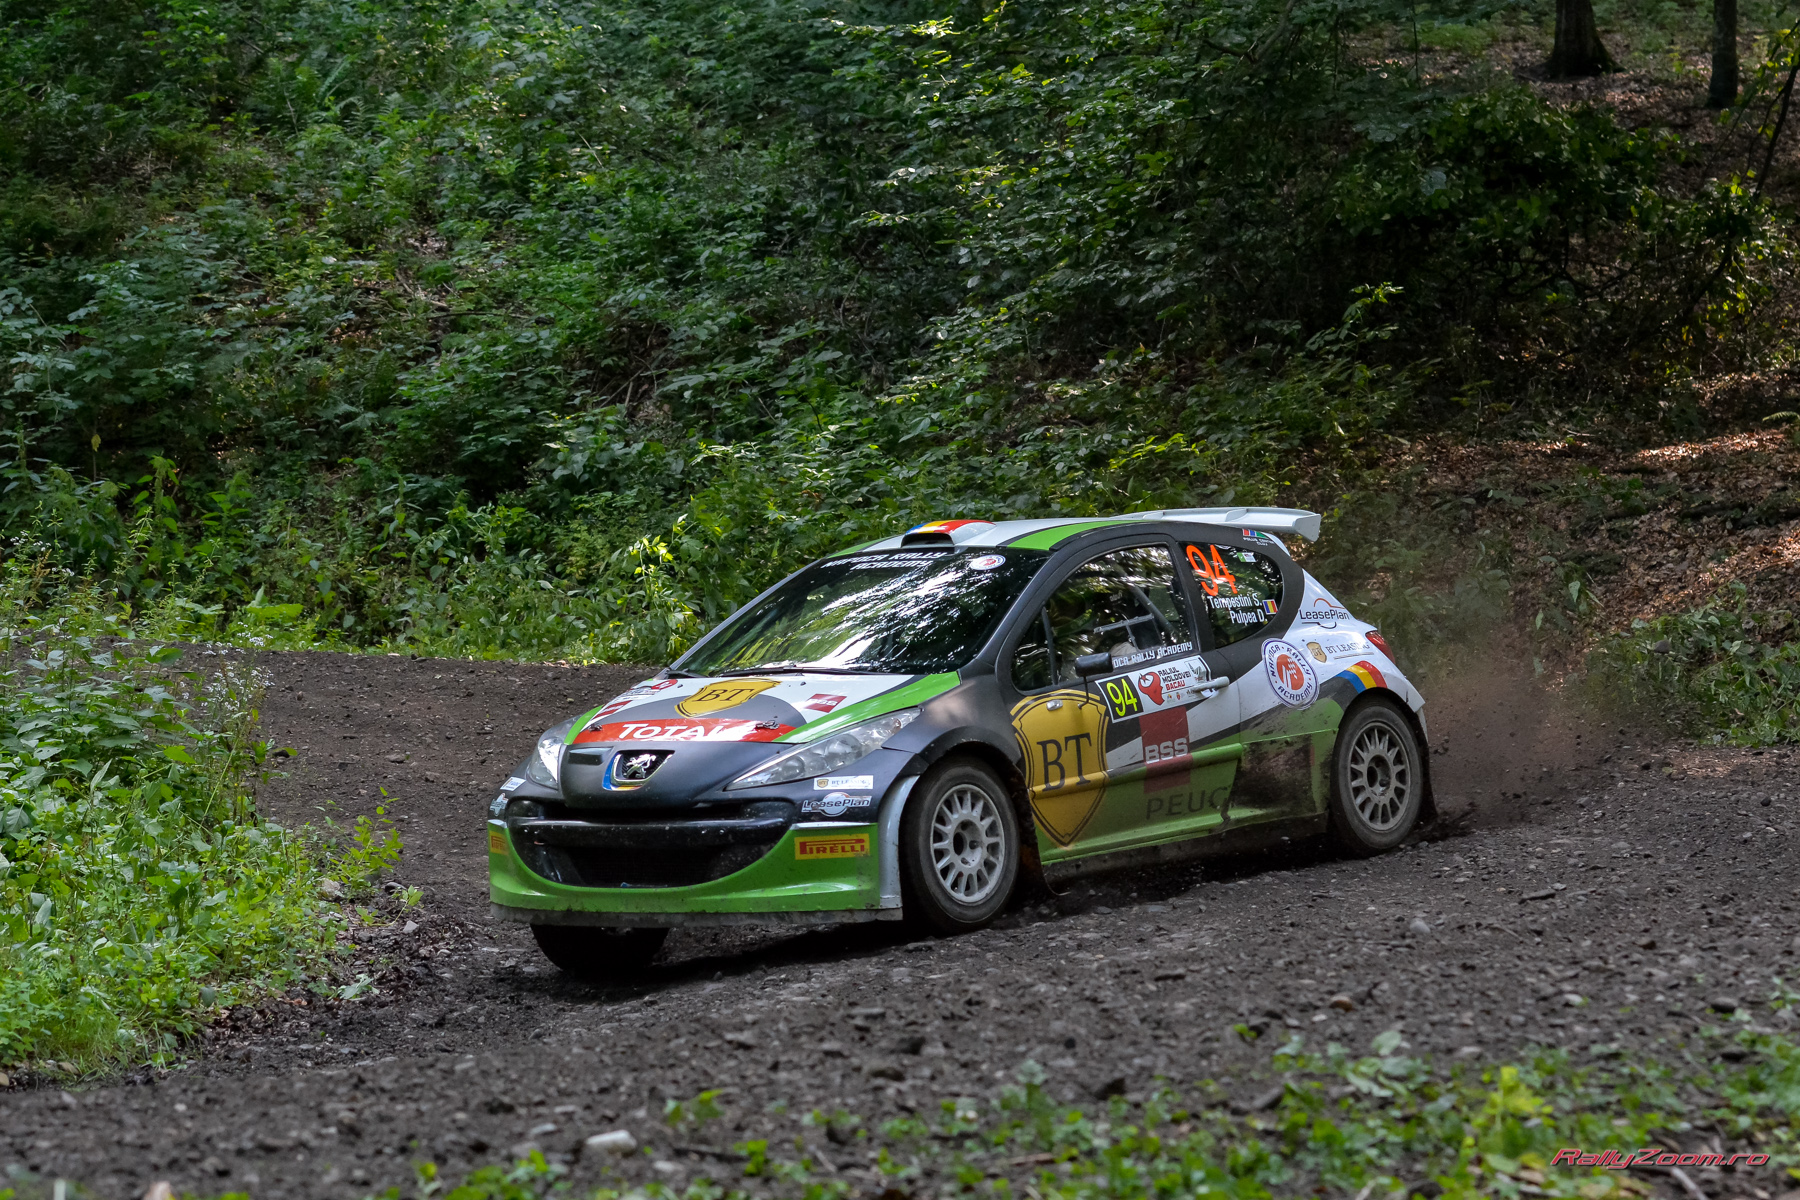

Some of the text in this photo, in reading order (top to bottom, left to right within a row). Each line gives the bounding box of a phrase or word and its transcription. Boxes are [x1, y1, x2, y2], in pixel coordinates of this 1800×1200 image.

[1186, 544, 1238, 596] 94
[1207, 592, 1263, 610] Tempestini S.
[1230, 609, 1268, 626] Pulpea D.
[1299, 608, 1350, 621] LeasePlan
[1131, 650, 1156, 664] RALLY
[1157, 641, 1193, 658] ACADEMY
[1325, 645, 1338, 654] BT
[1286, 647, 1312, 676] RALLY
[1157, 666, 1180, 677] RALIUL
[1161, 670, 1192, 684] MOLDOVEI
[696, 688, 755, 702] BT
[1106, 678, 1138, 717] 94
[1277, 682, 1313, 702] ACADEMY
[618, 723, 740, 741] TOTAL
[1145, 737, 1188, 765] BSS
[1037, 732, 1092, 792] BT
[803, 798, 870, 810] LeasePlan
[1146, 785, 1231, 821] PEUG
[799, 838, 866, 855] PIRELLI
